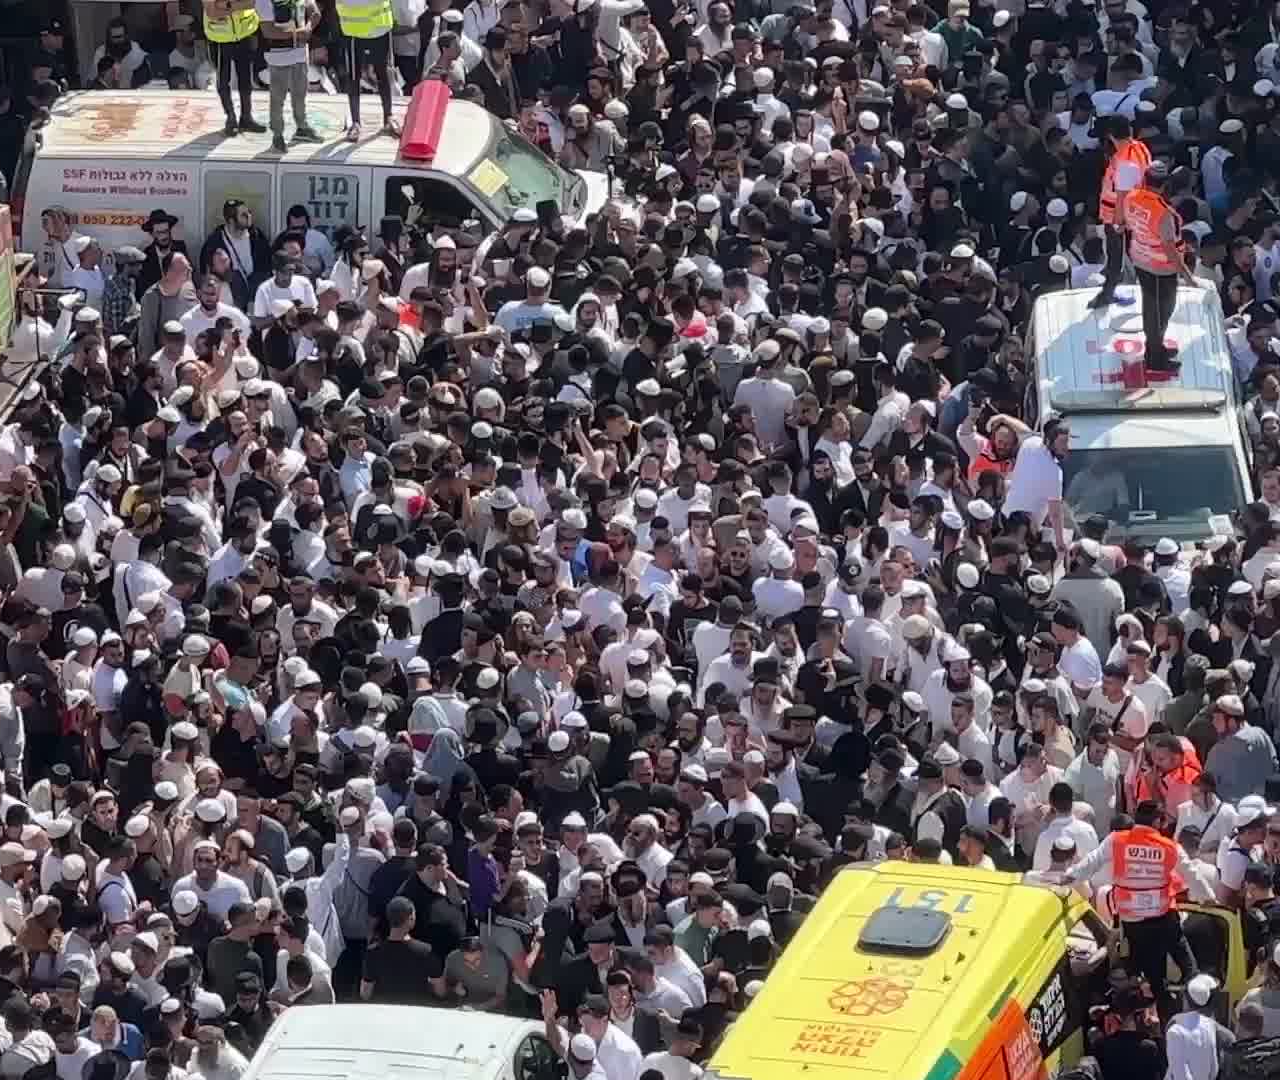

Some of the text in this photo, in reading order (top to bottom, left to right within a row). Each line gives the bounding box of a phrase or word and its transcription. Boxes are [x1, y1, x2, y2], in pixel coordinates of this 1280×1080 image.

[88, 168, 126, 181] גבולות
[130, 170, 153, 182] ללא
[156, 171, 188, 182] הצלה
[308, 176, 348, 199] מגן
[308, 202, 348, 218] דוד
[1128, 846, 1163, 860] חובש
